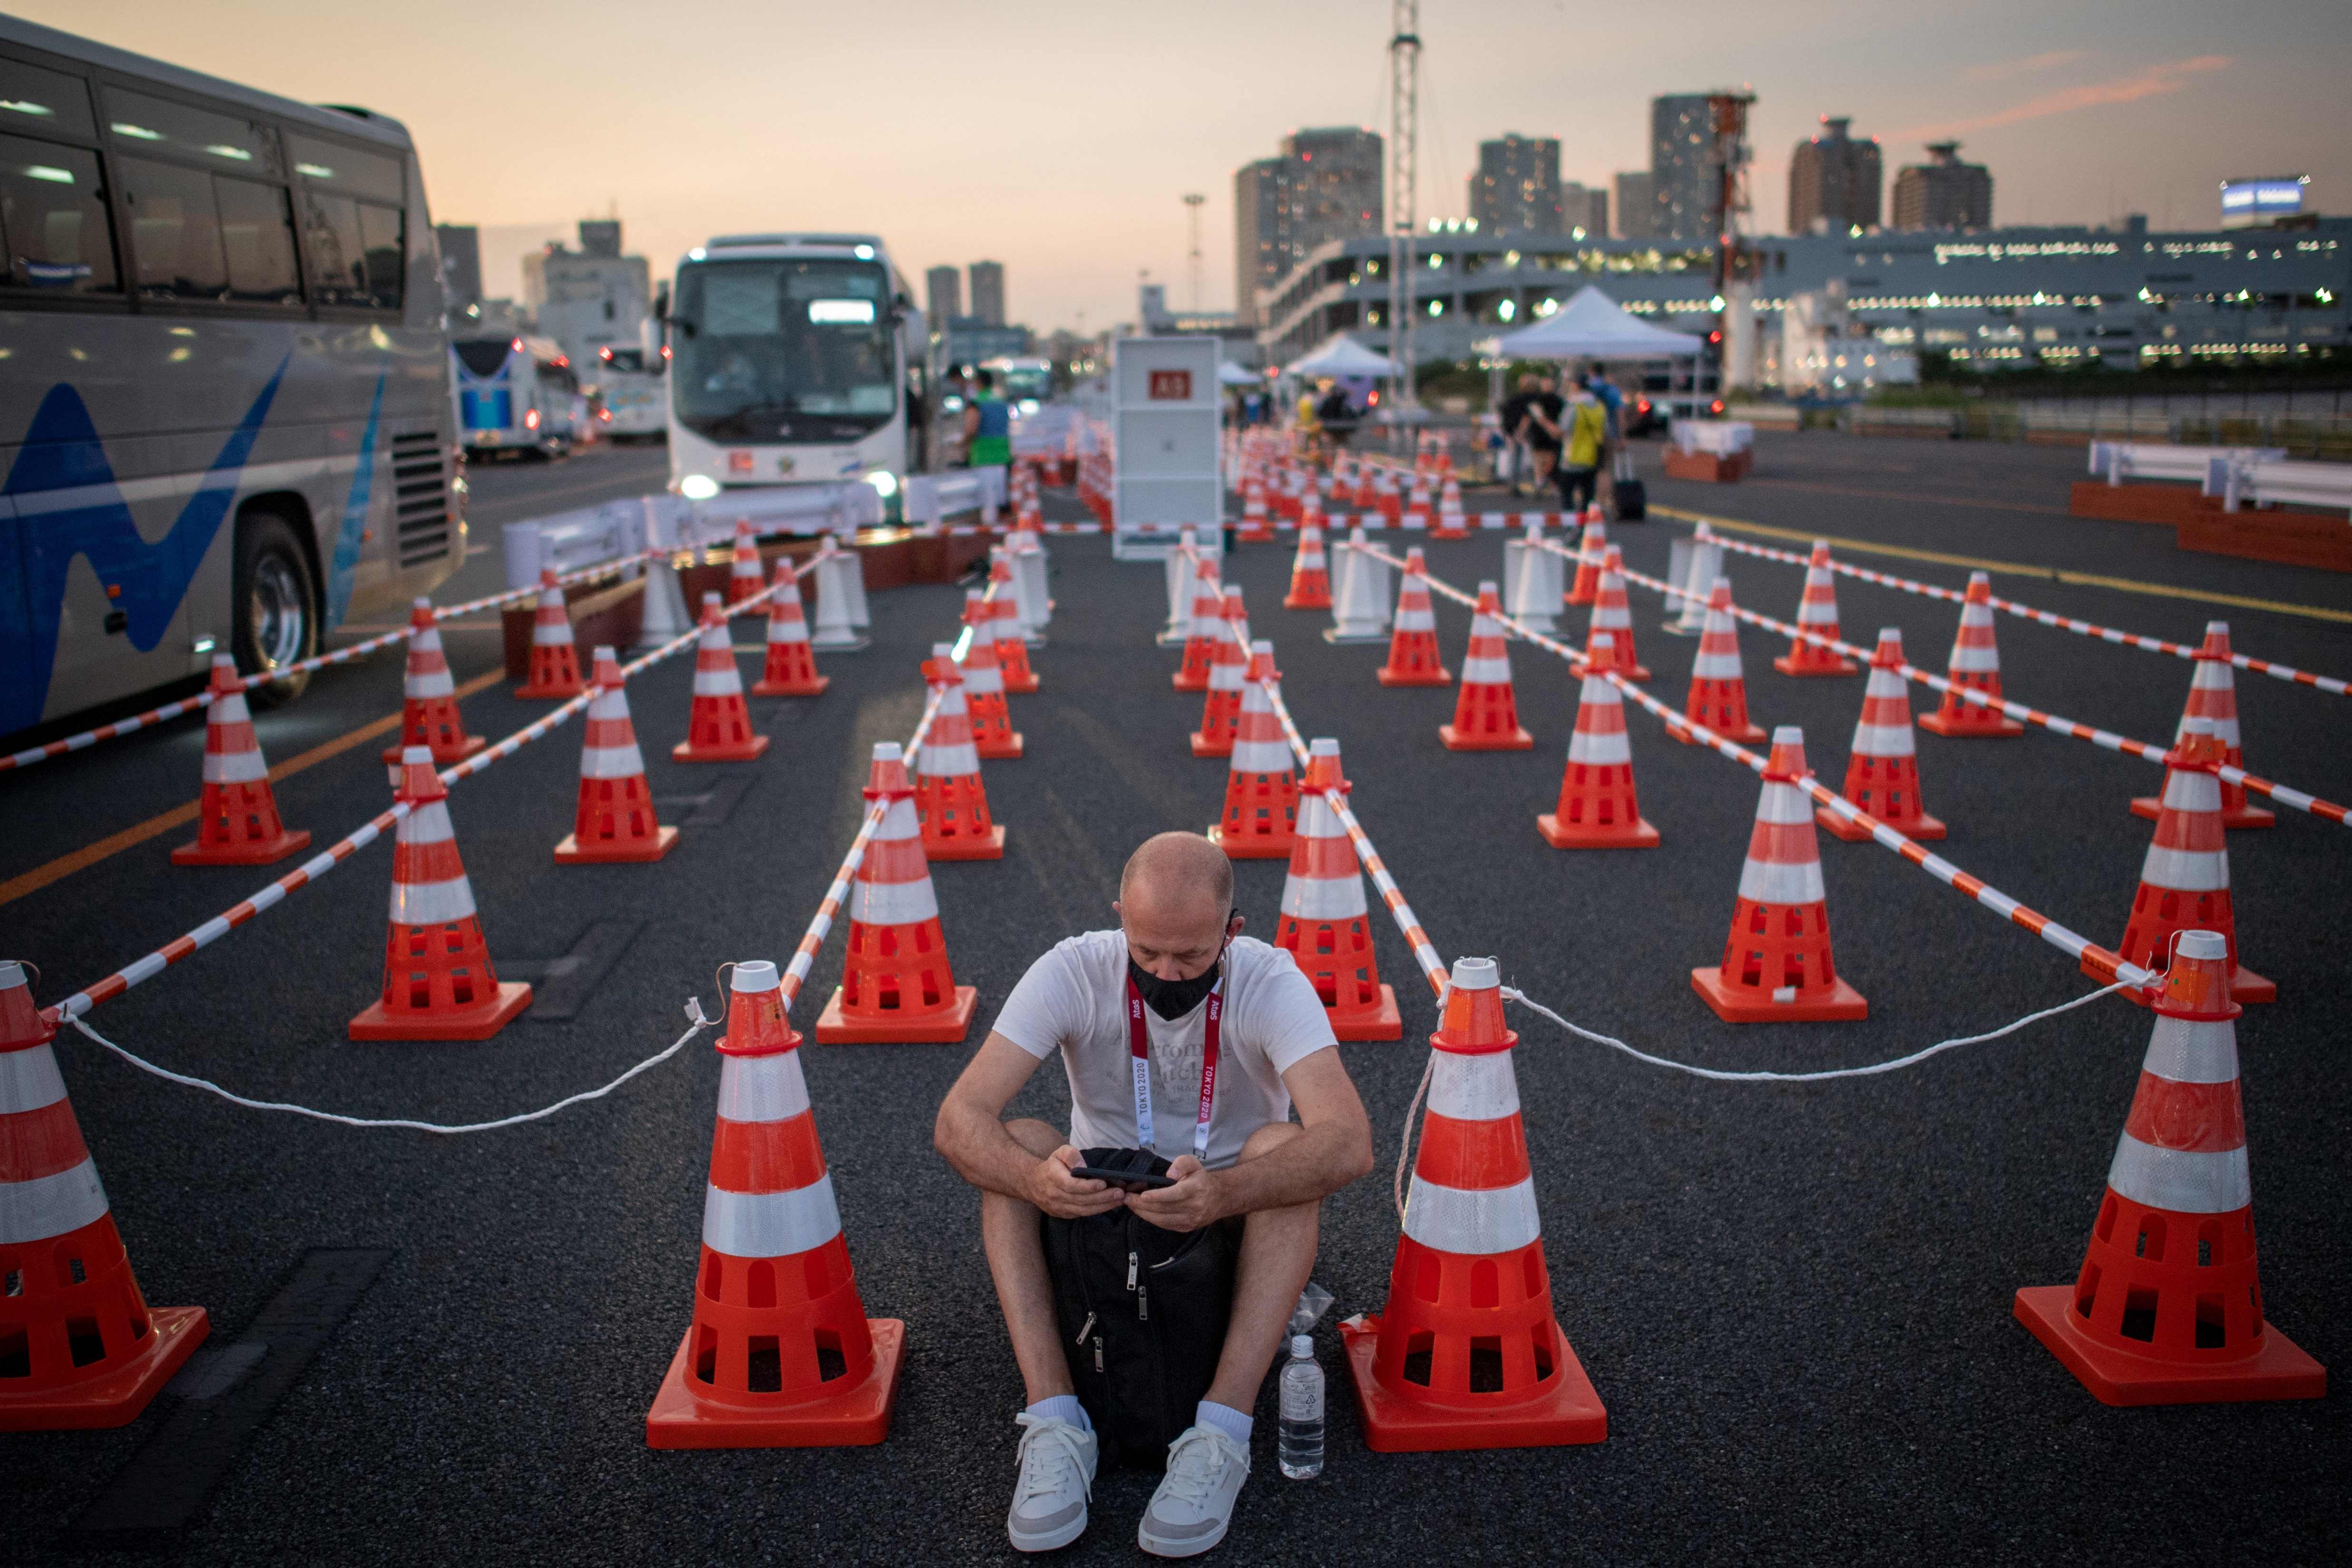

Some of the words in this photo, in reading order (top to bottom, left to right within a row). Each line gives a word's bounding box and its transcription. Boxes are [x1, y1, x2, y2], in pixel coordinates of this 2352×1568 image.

[1137, 1062, 1145, 1084] 2020
[1203, 1066, 1213, 1095] TOKYO
[1138, 1087, 1147, 1115] TOKYO
[1200, 1095, 1210, 1119] 2020
